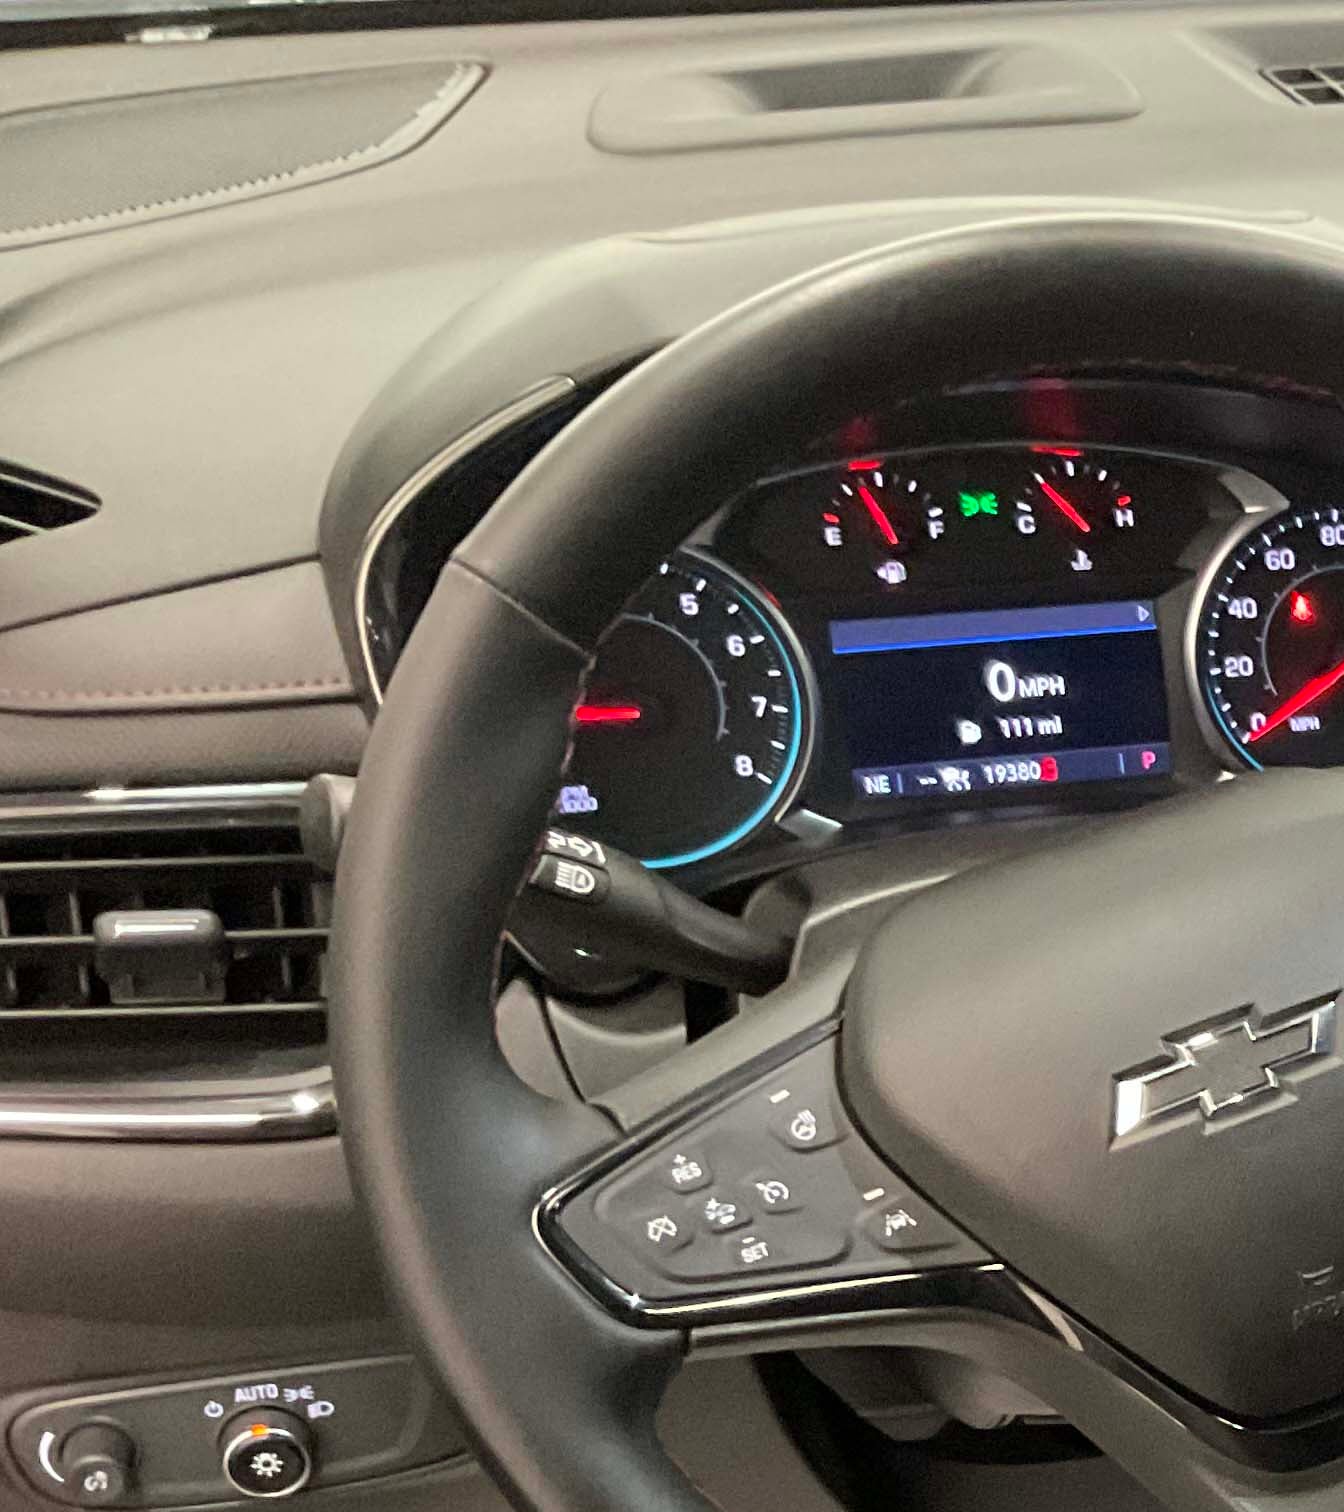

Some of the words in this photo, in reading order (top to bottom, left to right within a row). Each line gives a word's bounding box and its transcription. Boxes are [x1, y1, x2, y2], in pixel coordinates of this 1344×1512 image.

[928, 519, 945, 540] F
[1016, 514, 1037, 535] C
[1115, 508, 1135, 528] H
[824, 526, 843, 547] E
[1264, 548, 1296, 572] 60
[679, 592, 700, 616] 5
[1227, 596, 1258, 620] 40
[725, 634, 746, 658] 6
[1224, 655, 1254, 678] 20
[750, 694, 768, 718] 7
[998, 716, 1034, 740] 111
[734, 754, 755, 777] 8
[863, 774, 892, 795] NE
[1141, 750, 1157, 769] P
[671, 1161, 702, 1184] RES
[741, 1241, 769, 1263] SET
[235, 1383, 278, 1403] AUTO
